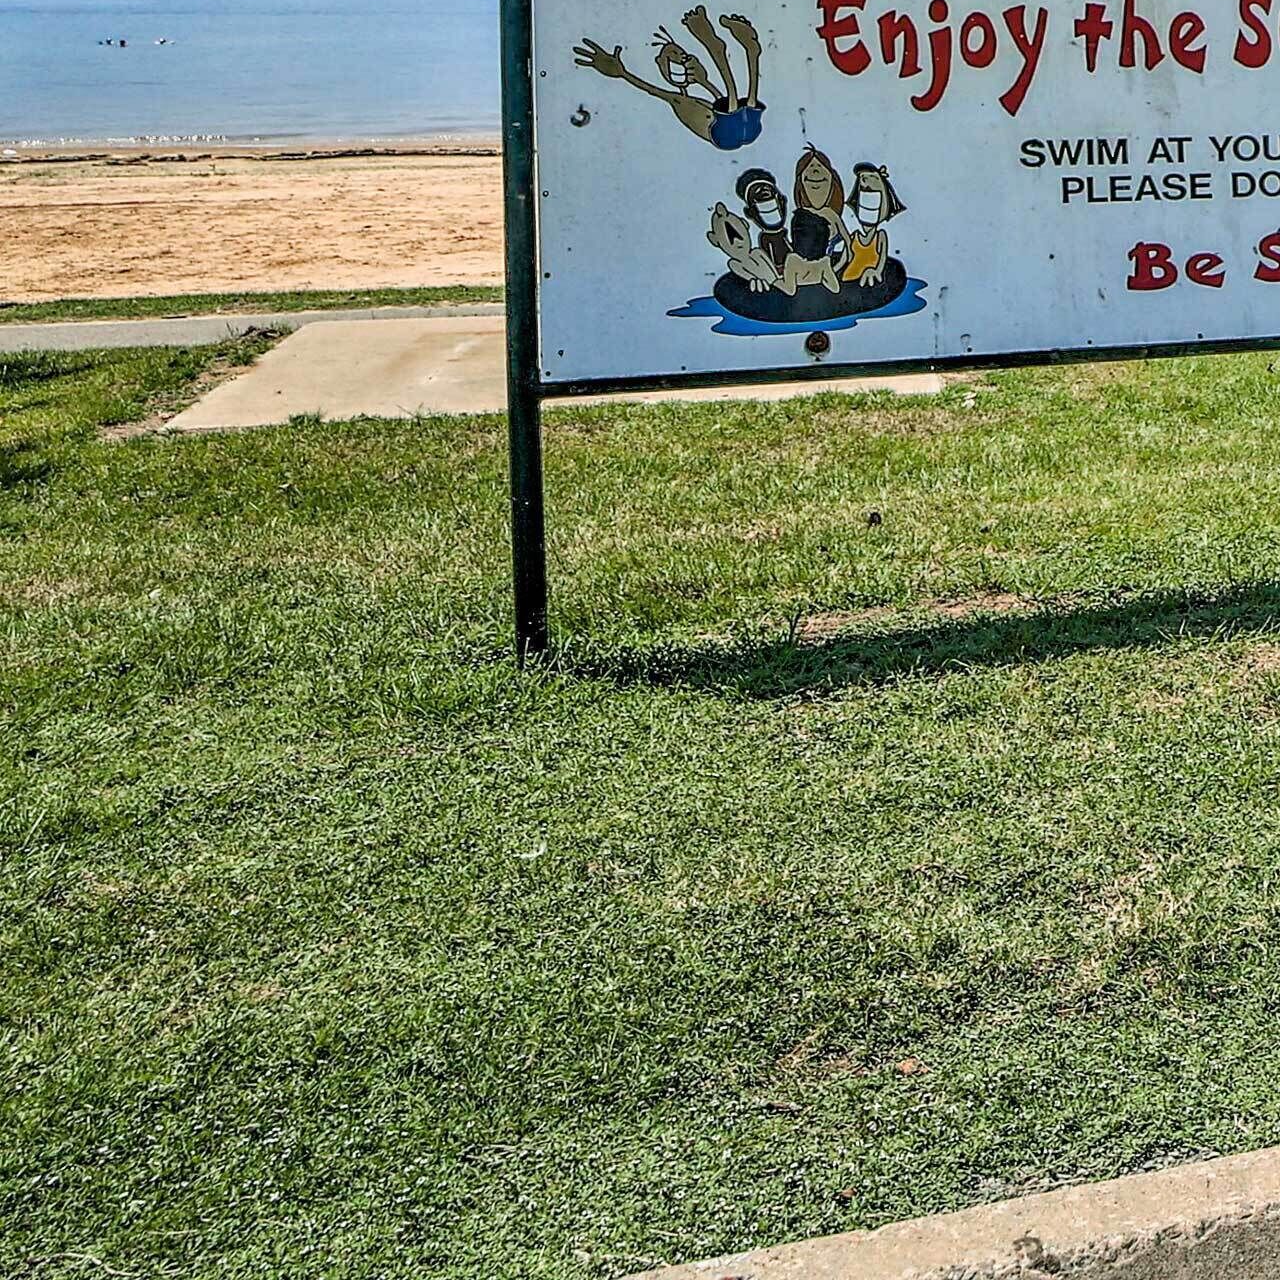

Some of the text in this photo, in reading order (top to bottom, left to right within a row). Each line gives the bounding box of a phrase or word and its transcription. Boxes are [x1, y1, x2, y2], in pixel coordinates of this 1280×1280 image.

[1019, 137, 1129, 168] SWIM
[1147, 136, 1193, 165] AT
[1061, 172, 1213, 204] PLEASE
[1126, 240, 1227, 291] Be
